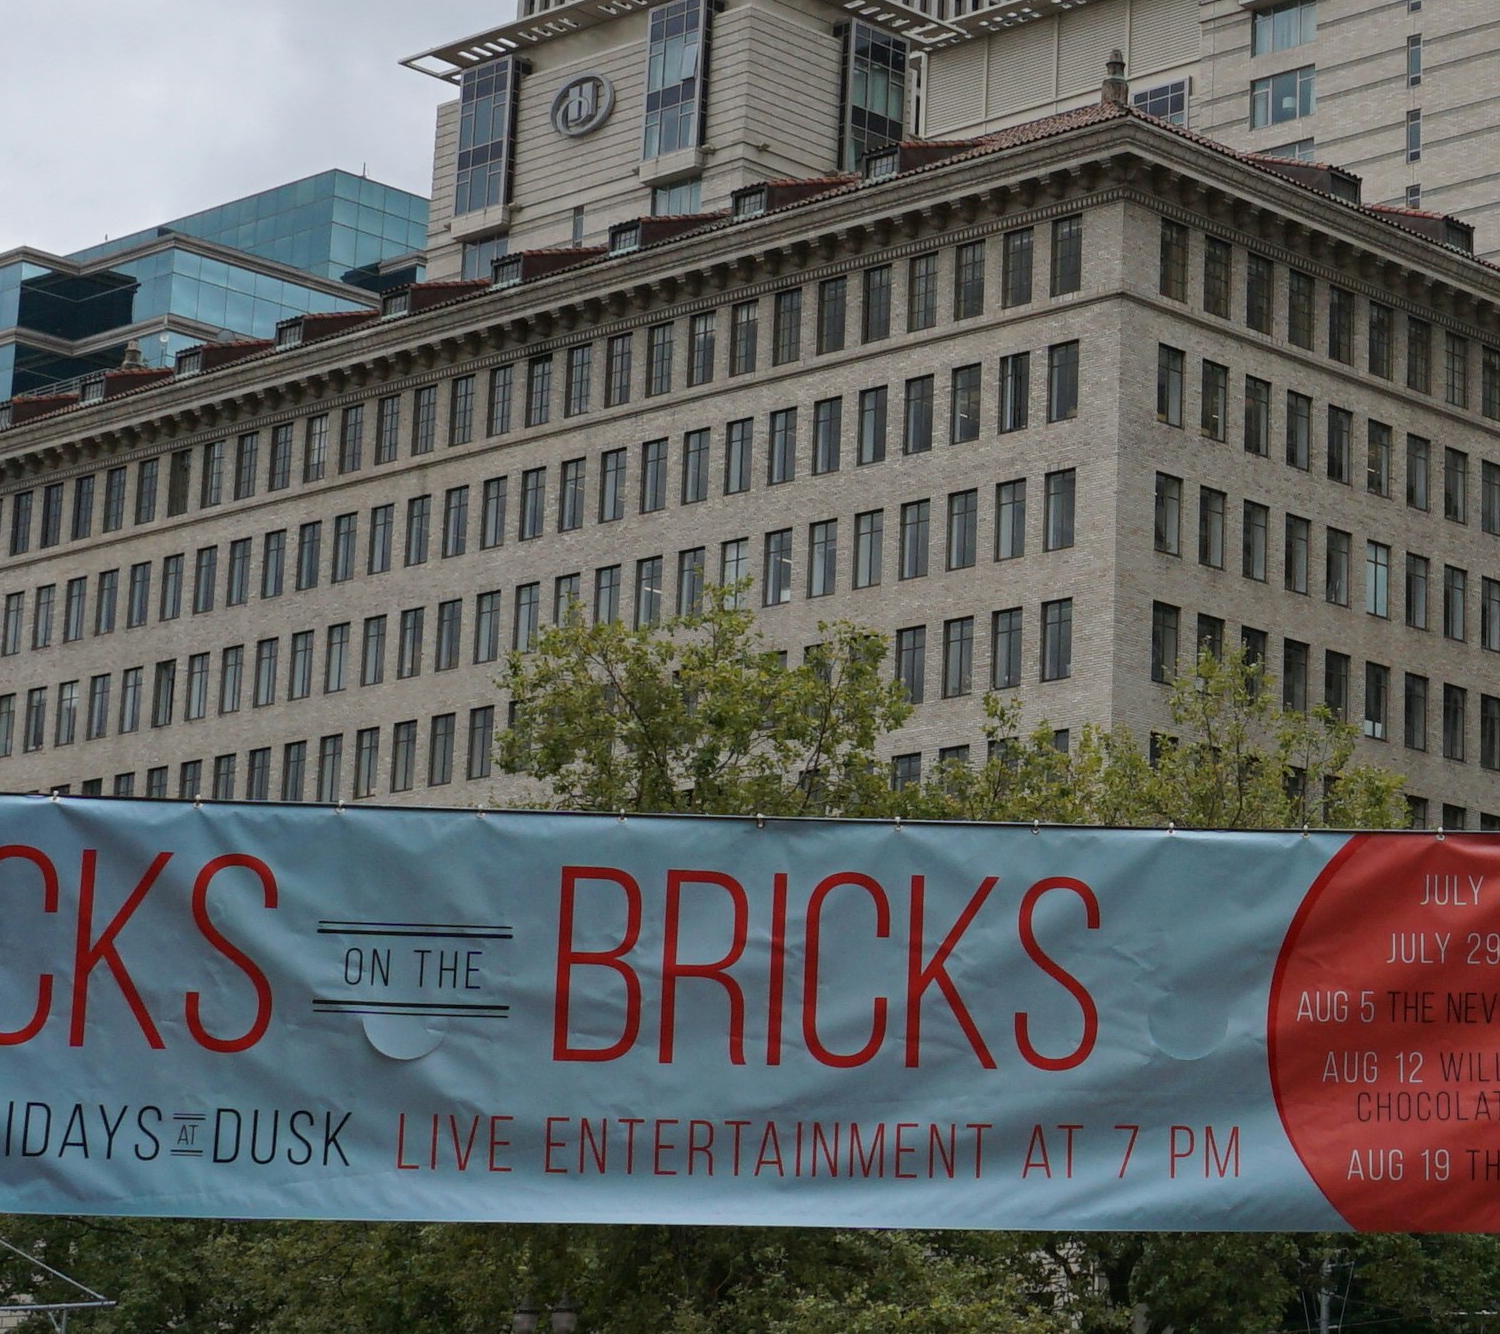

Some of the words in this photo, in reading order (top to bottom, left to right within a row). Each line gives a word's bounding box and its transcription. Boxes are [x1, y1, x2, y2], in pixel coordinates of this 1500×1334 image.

[1419, 873, 1485, 906] JULY
[1385, 931, 1451, 964] JULY
[344, 947, 391, 987] ON
[413, 949, 483, 989] THE
[552, 866, 1102, 1071] BRICKS
[1296, 990, 1349, 1024] AUG
[1359, 990, 1376, 1023] 5
[1386, 990, 1435, 1023] THE
[1321, 1051, 1379, 1084] AUG
[1395, 1051, 1425, 1084] 12
[176, 1123, 199, 1147] AT
[212, 1107, 353, 1167] DUSK
[396, 1112, 515, 1172] LIVE
[544, 1116, 994, 1179] ENTERTAINMENT
[1021, 1123, 1085, 1180] AT
[1113, 1124, 1140, 1179] 7
[1169, 1124, 1241, 1179] PM
[1346, 1147, 1404, 1183] AUG
[1419, 1147, 1451, 1183] 19
